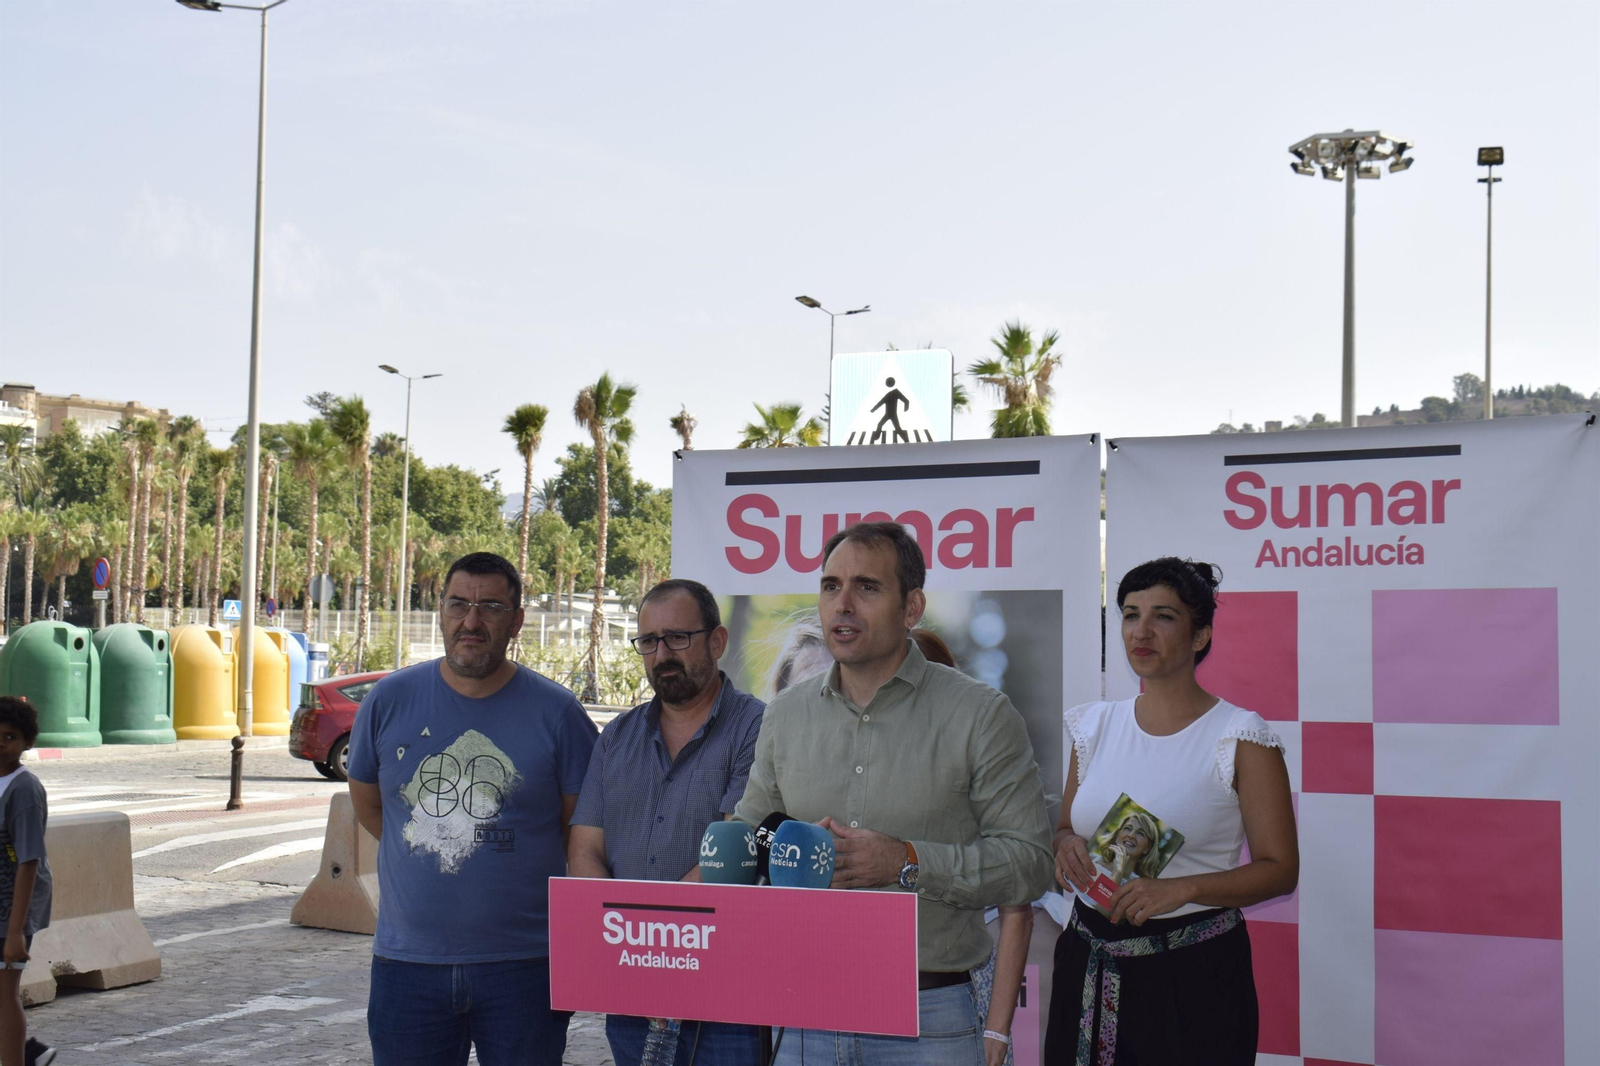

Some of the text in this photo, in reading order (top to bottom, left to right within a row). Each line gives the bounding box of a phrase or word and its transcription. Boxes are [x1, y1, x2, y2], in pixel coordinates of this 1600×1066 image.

[1223, 471, 1462, 530] Sumar
[1255, 535, 1424, 568] Andalucía
[771, 857, 798, 868] Noticias
[602, 911, 716, 949] Sumar
[618, 949, 700, 970] Andalucía
